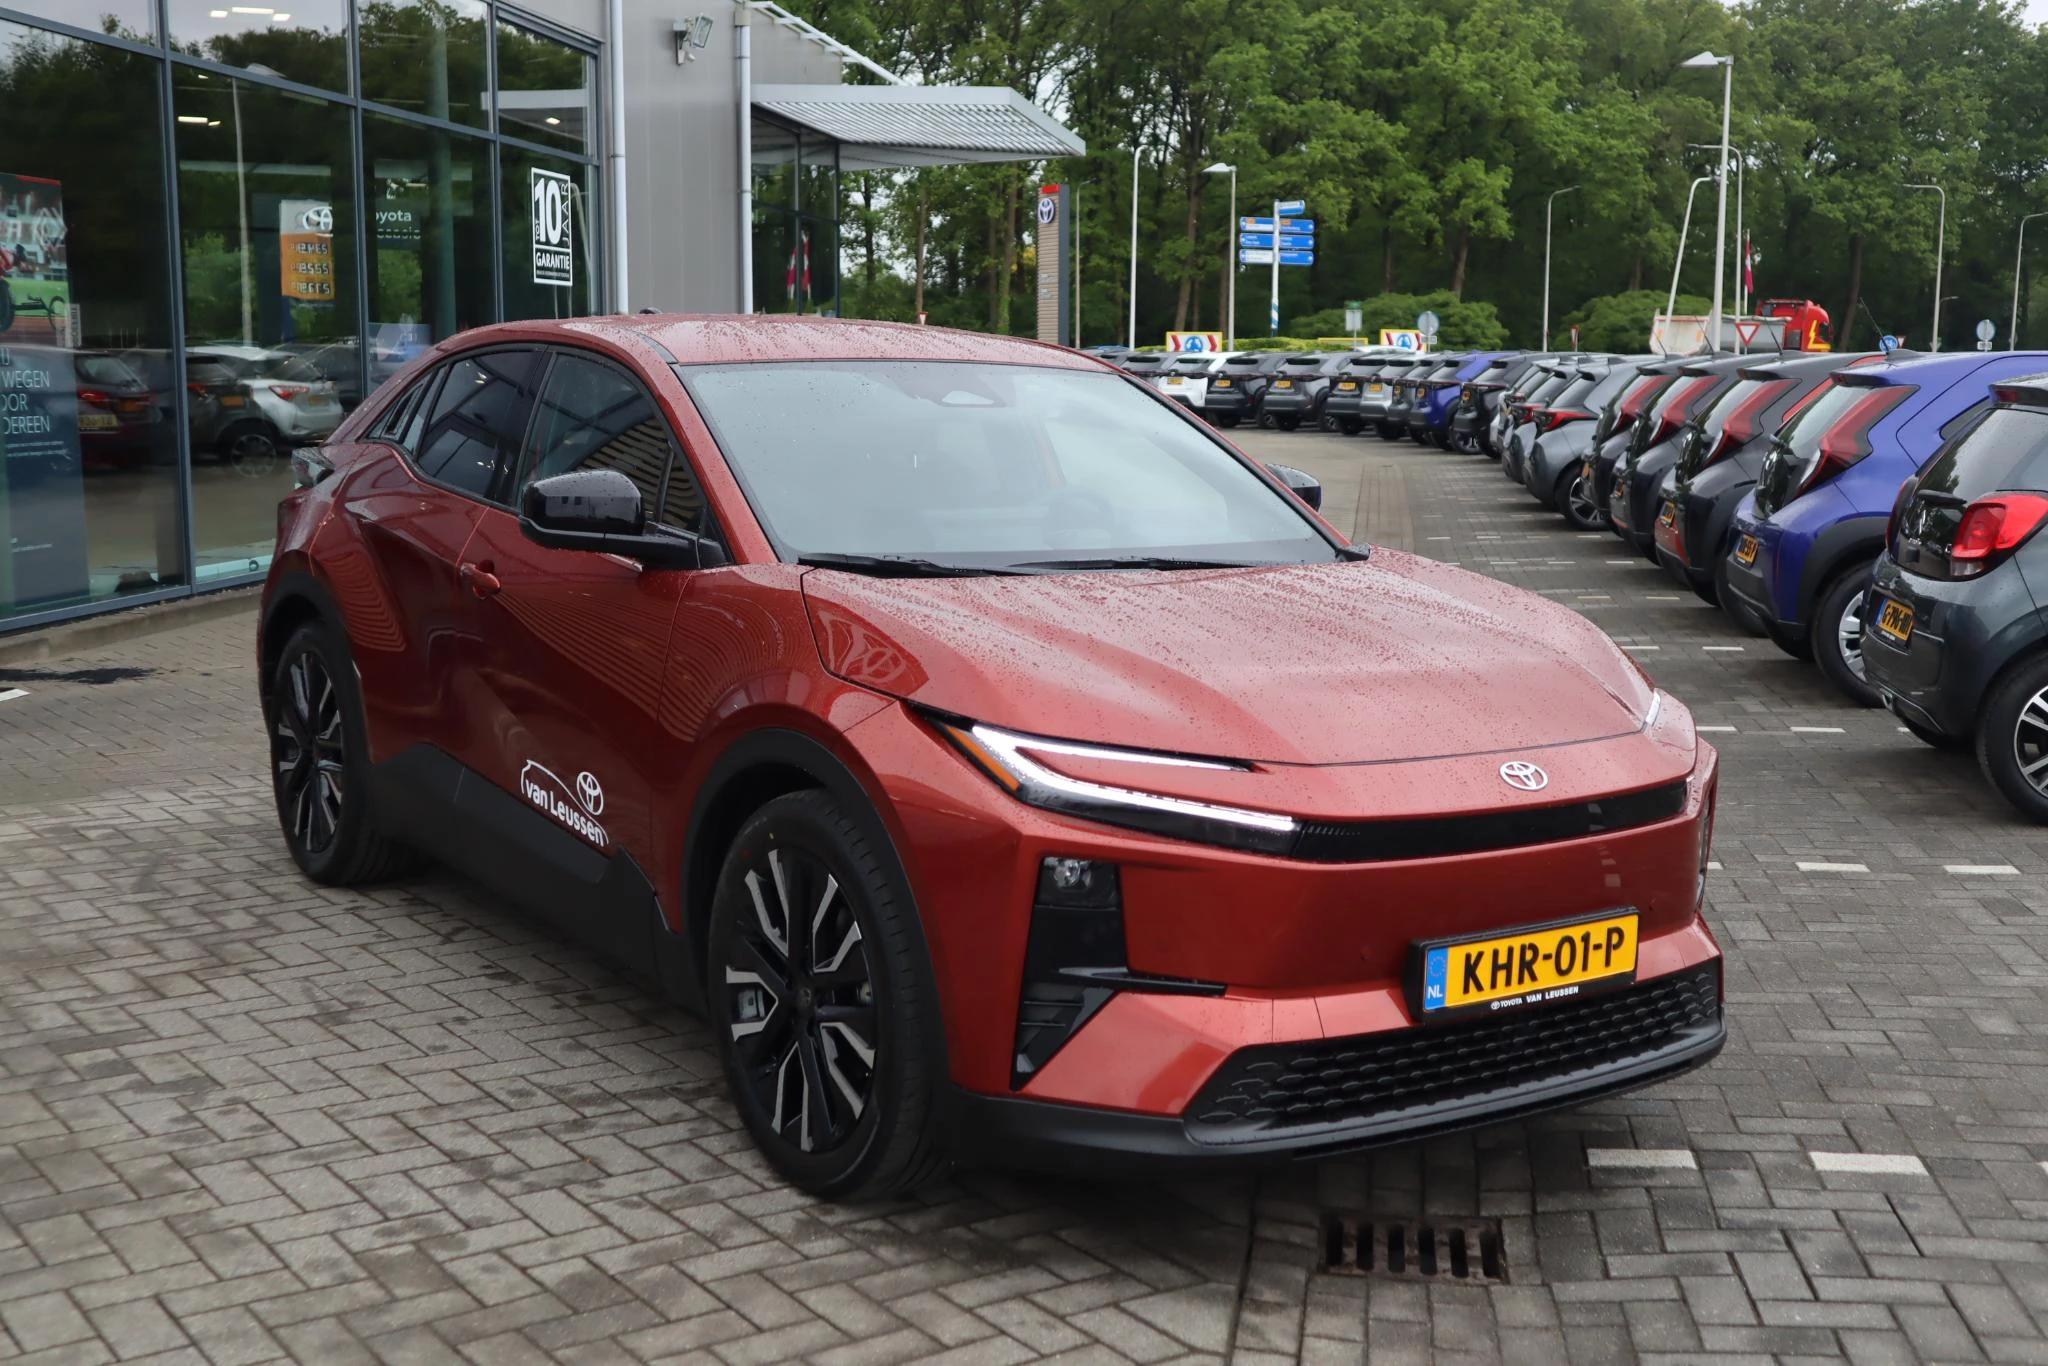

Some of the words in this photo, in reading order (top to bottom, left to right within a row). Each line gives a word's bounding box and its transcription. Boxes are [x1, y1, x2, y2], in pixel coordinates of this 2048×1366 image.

[535, 177, 562, 245] 10
[561, 183, 570, 246] JAAR
[536, 251, 570, 270] GARANTIE
[525, 779, 549, 810] van
[550, 791, 605, 847] Leussen
[1427, 984, 1443, 1000] NL
[1462, 926, 1625, 995] KHR-01-P
[1500, 998, 1523, 1008] TOYOTA
[1526, 993, 1542, 1004] VAN
[1545, 985, 1579, 1000] LEUSSEN
